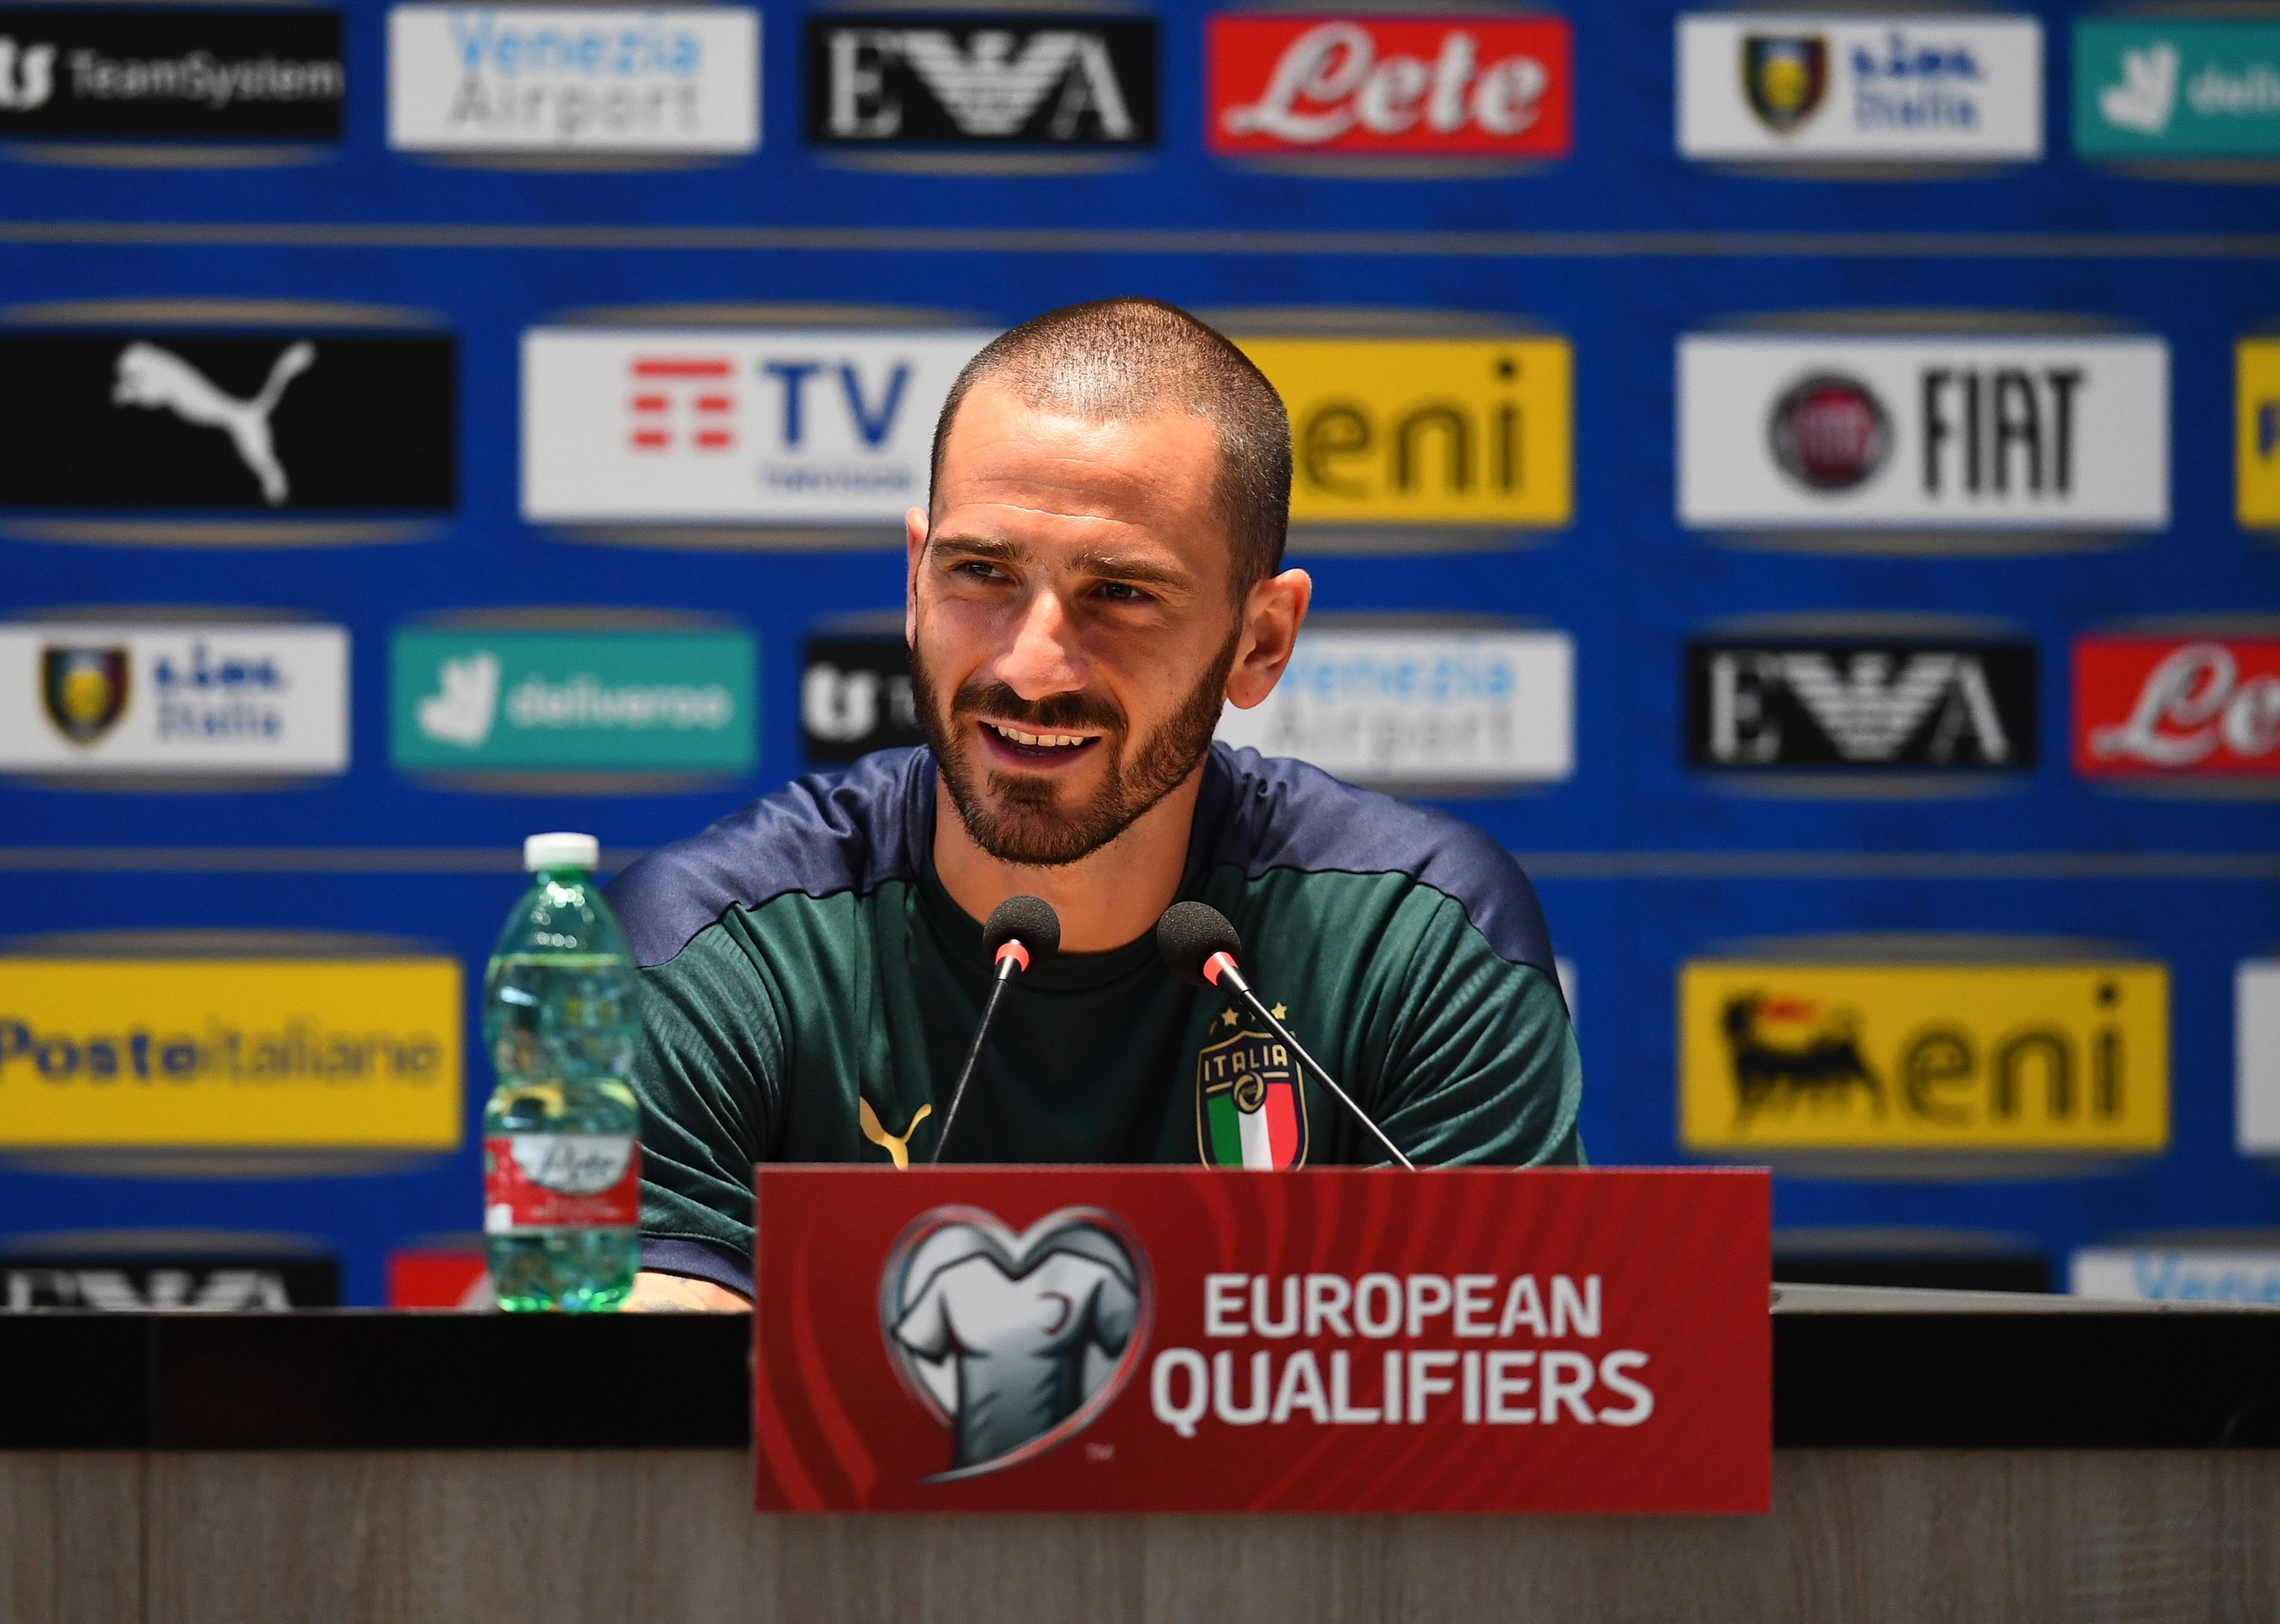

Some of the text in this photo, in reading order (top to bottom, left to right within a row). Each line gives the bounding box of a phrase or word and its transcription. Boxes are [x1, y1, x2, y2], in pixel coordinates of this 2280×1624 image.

[445, 9, 704, 77] Venezia
[1218, 20, 1550, 142] Lete
[446, 72, 702, 142] Airport
[759, 355, 913, 451] TV
[1298, 358, 1522, 500] eni
[1921, 363, 2088, 503] FIAT
[1203, 1043, 1289, 1083] ITALIA
[1901, 979, 2123, 1122] eni
[1204, 1272, 1602, 1339] EUROPEAN
[1150, 1347, 1655, 1438] QUALIFIERS
